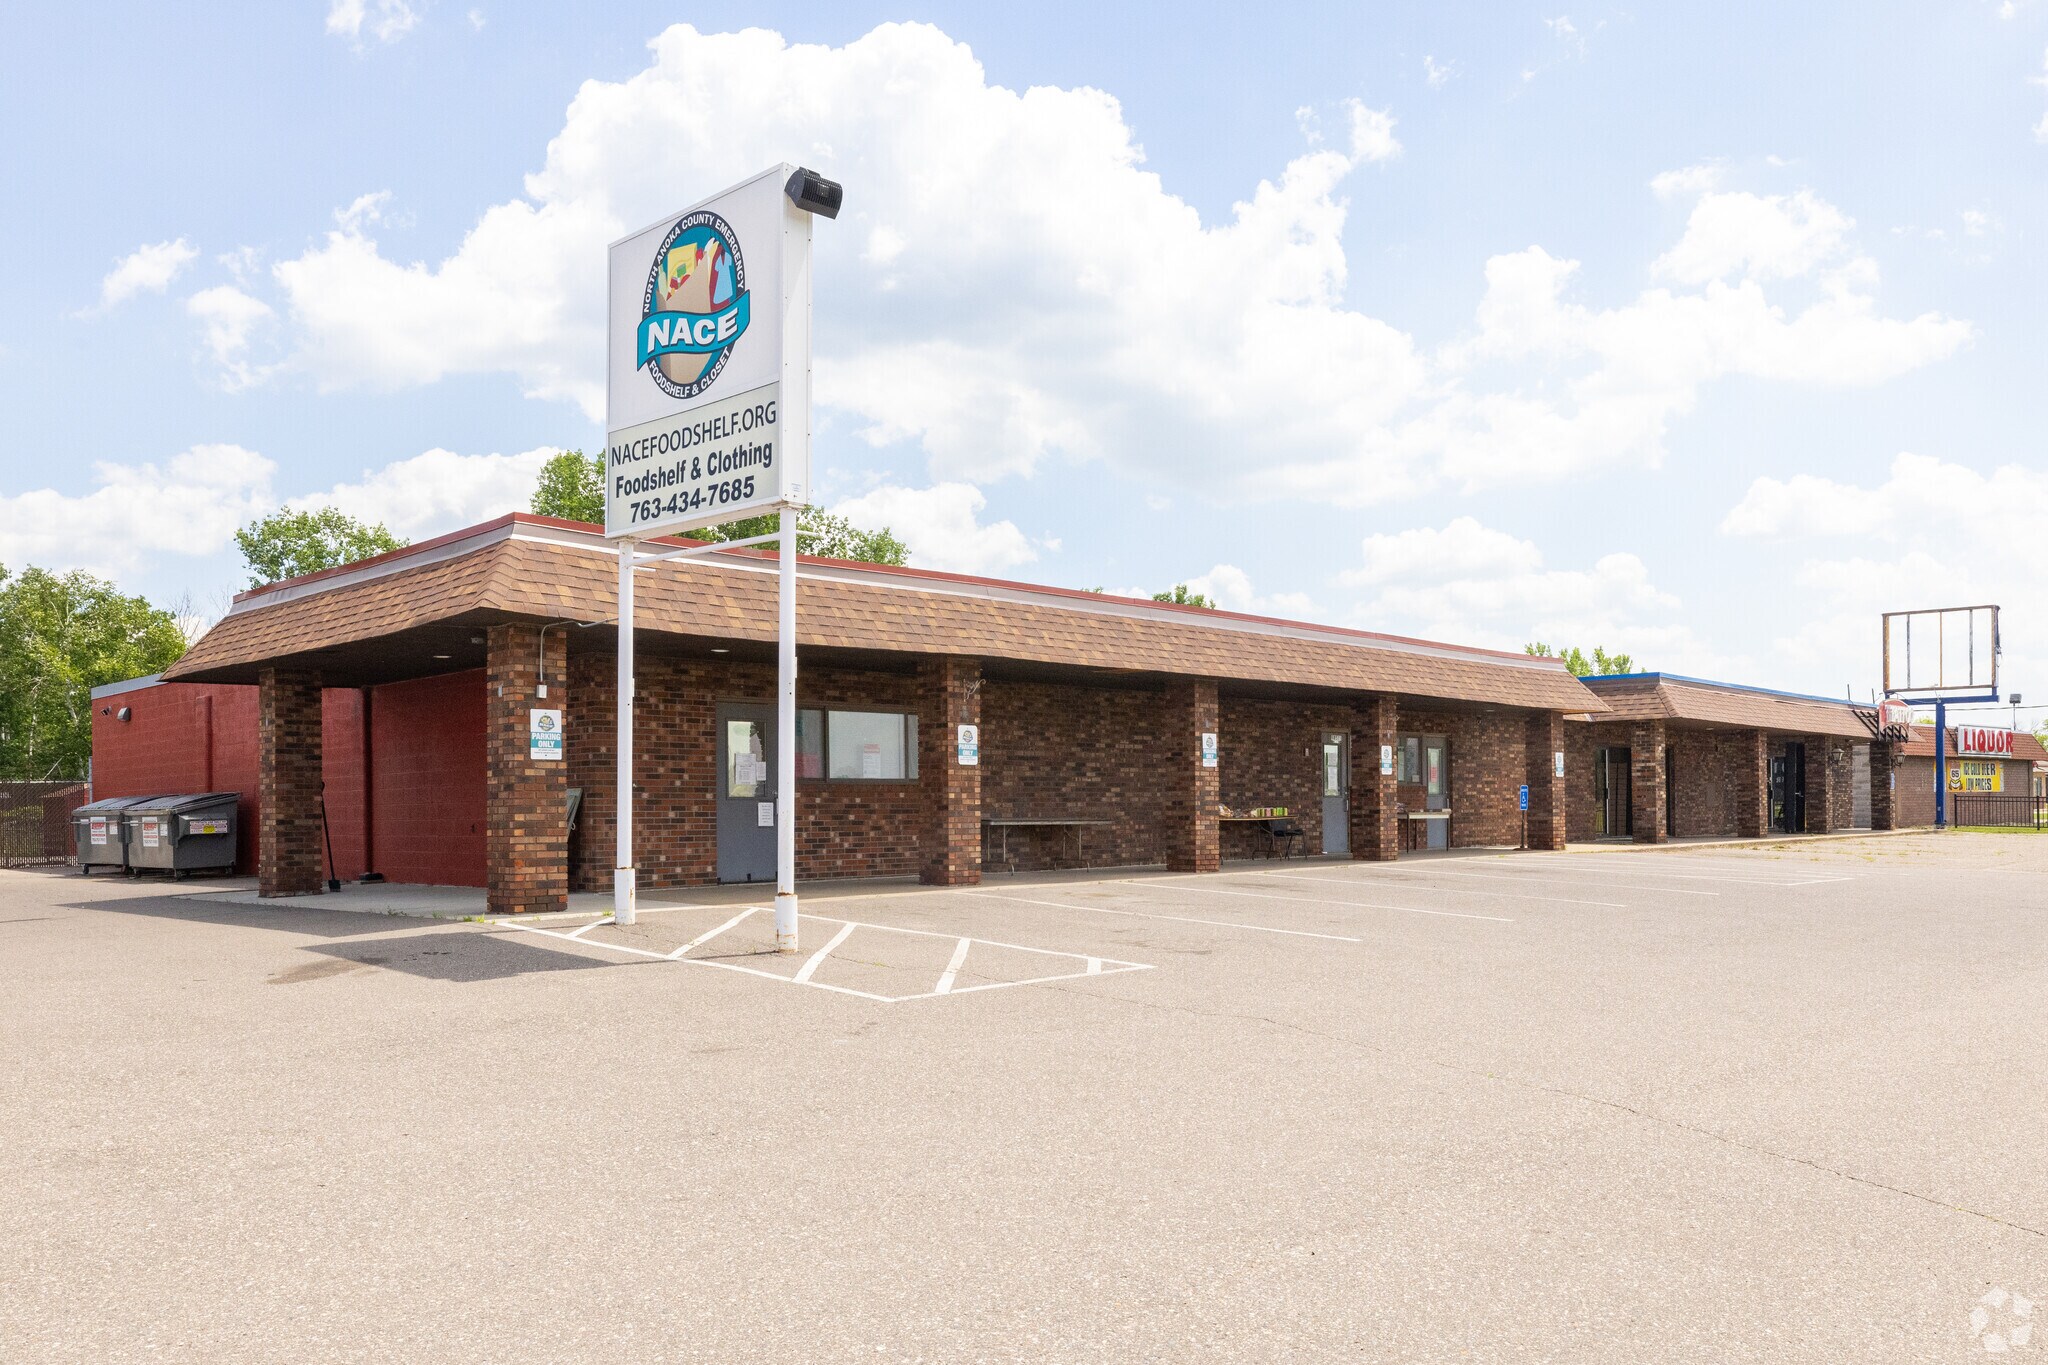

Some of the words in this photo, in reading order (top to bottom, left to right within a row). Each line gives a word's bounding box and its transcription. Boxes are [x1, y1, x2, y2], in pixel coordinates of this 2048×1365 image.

[644, 266, 658, 312] NORTH
[656, 227, 681, 264] ANOKA
[681, 213, 715, 230] COUNTY
[715, 218, 744, 288] EMERGENCY
[647, 307, 738, 354] NACE
[649, 360, 690, 398] FOODSHELF
[691, 384, 699, 395] &
[700, 346, 731, 389] CLOSET
[611, 400, 777, 467] NACEFOODSHELF.ORG
[616, 459, 687, 498] Foodshelf
[690, 456, 701, 480] &
[707, 441, 773, 468] Clothing
[630, 475, 755, 523] 763-434-7685
[532, 732, 561, 741] PARKING
[537, 740, 555, 748] ONLY
[1963, 728, 2014, 753] LIQUOR
